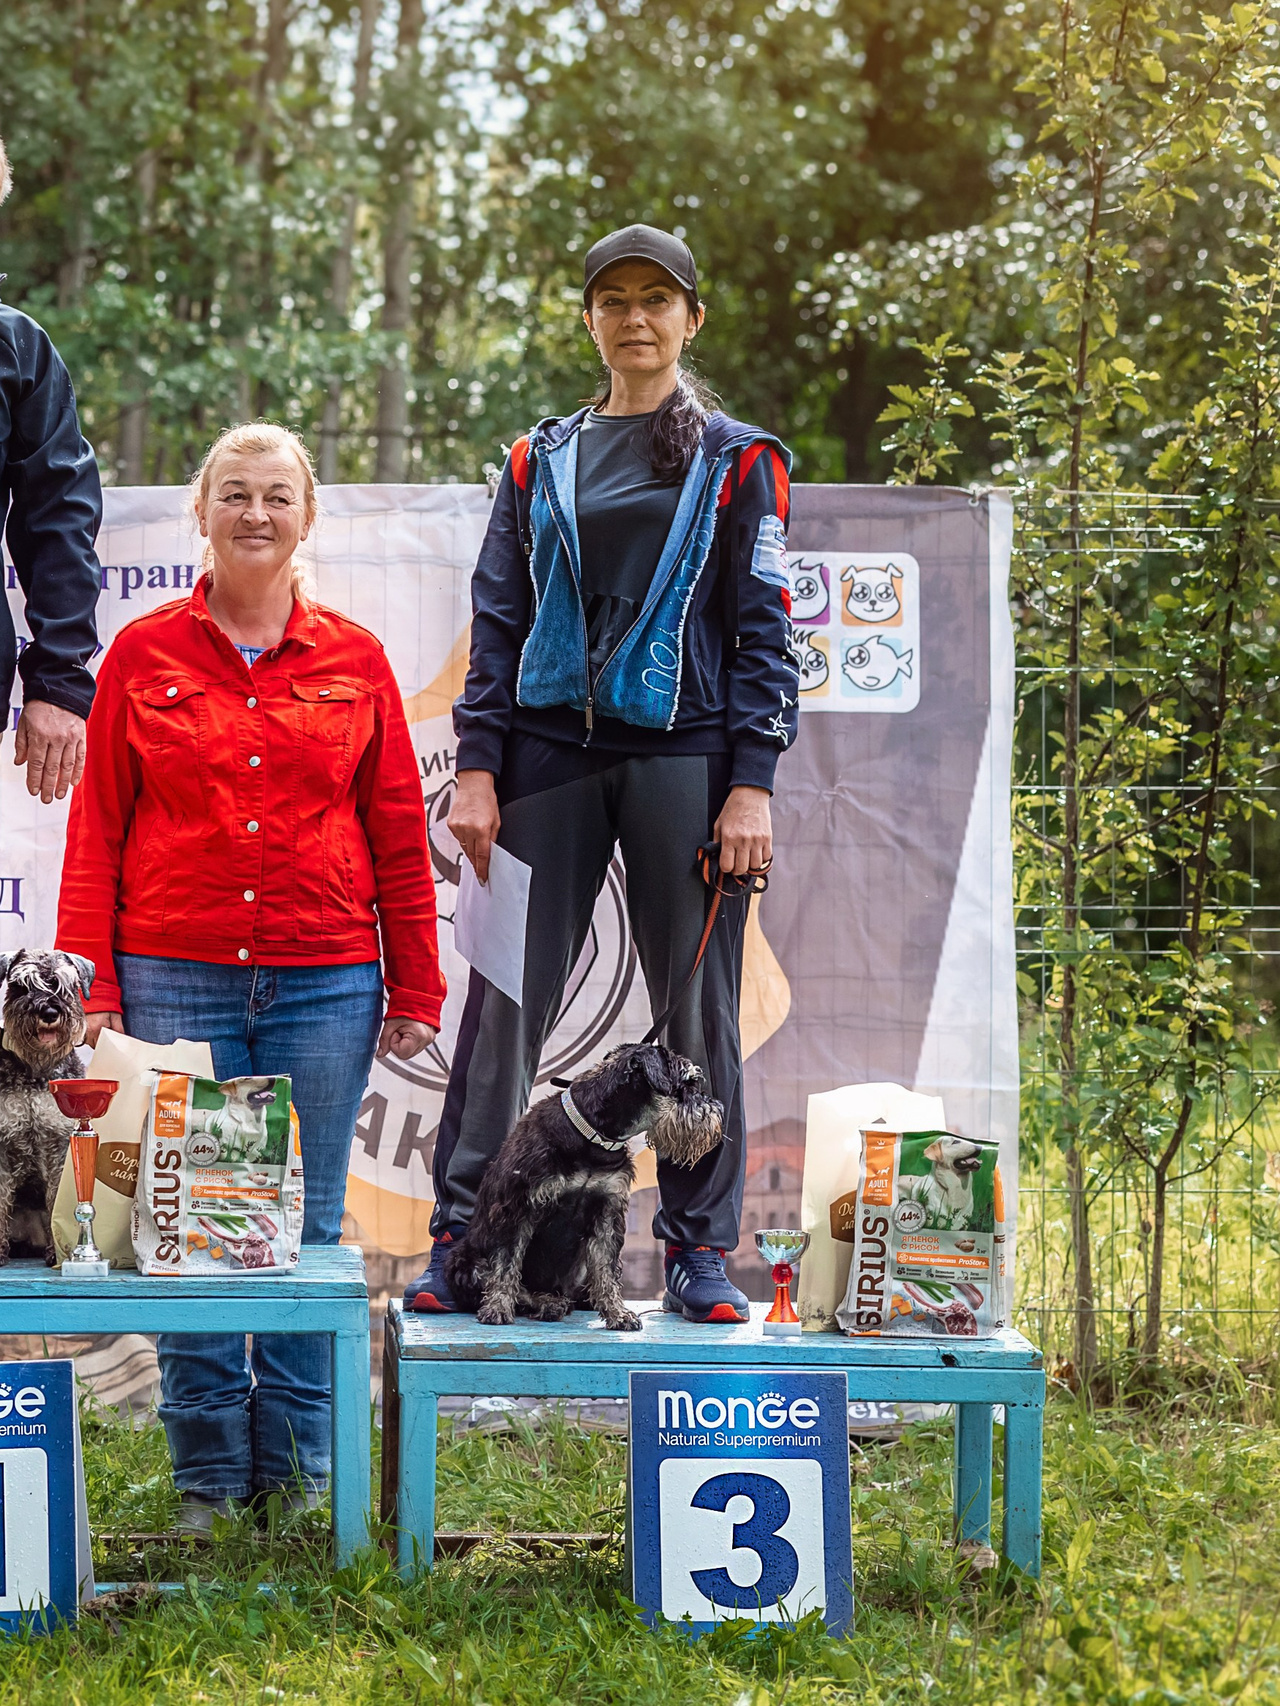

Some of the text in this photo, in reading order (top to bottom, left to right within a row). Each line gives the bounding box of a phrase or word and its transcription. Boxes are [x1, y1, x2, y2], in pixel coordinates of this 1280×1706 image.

[158, 1110, 182, 1119] ADULT
[193, 1144, 214, 1154] 44%
[195, 1168, 234, 1177] ЯГНЕНОК
[900, 1211, 920, 1222] 44%
[902, 1235, 940, 1244] ЯГНЕНОК
[856, 1216, 889, 1326] SIRIUS
[658, 1431, 820, 1449] Natural Superpremium
[689, 1472, 800, 1610] 3
